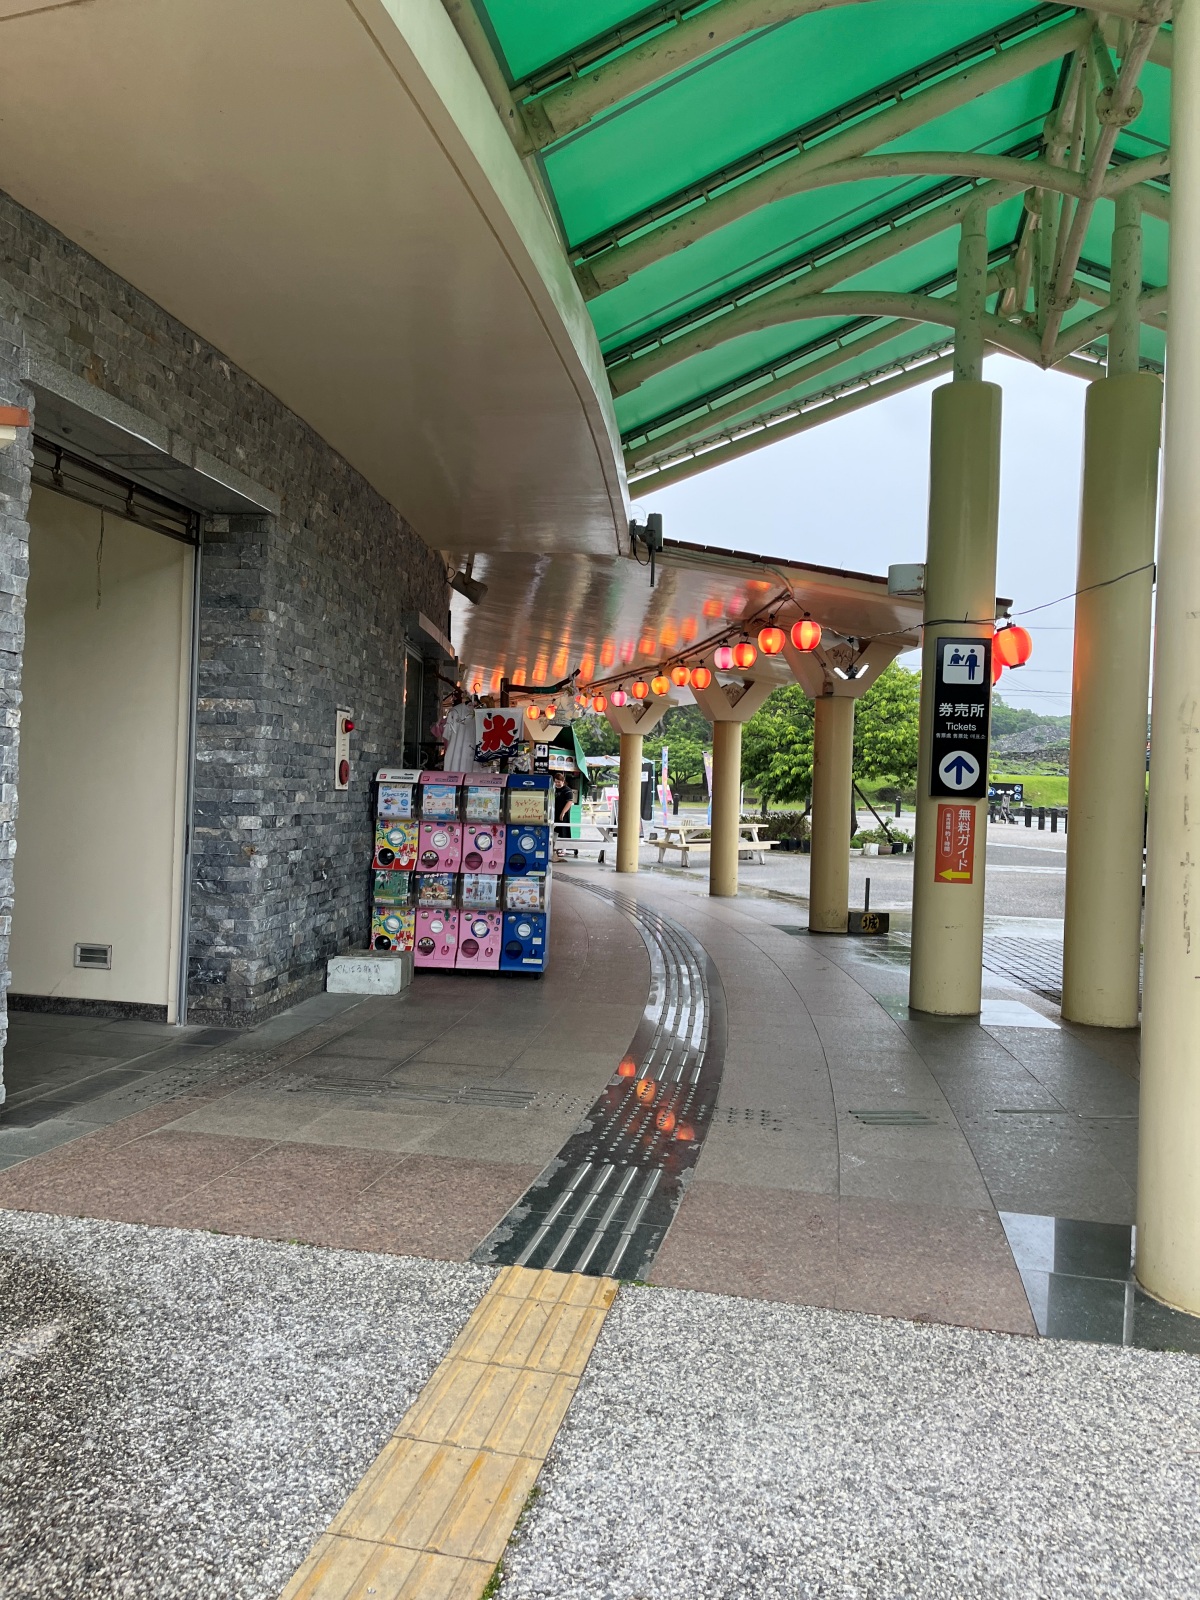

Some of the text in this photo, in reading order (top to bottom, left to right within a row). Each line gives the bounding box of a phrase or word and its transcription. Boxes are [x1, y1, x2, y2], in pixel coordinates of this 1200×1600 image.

[939, 702, 985, 718] 券売所
[481, 714, 516, 752] 氷
[946, 722, 977, 731] Tickets
[957, 808, 972, 871] 無料ガイド
